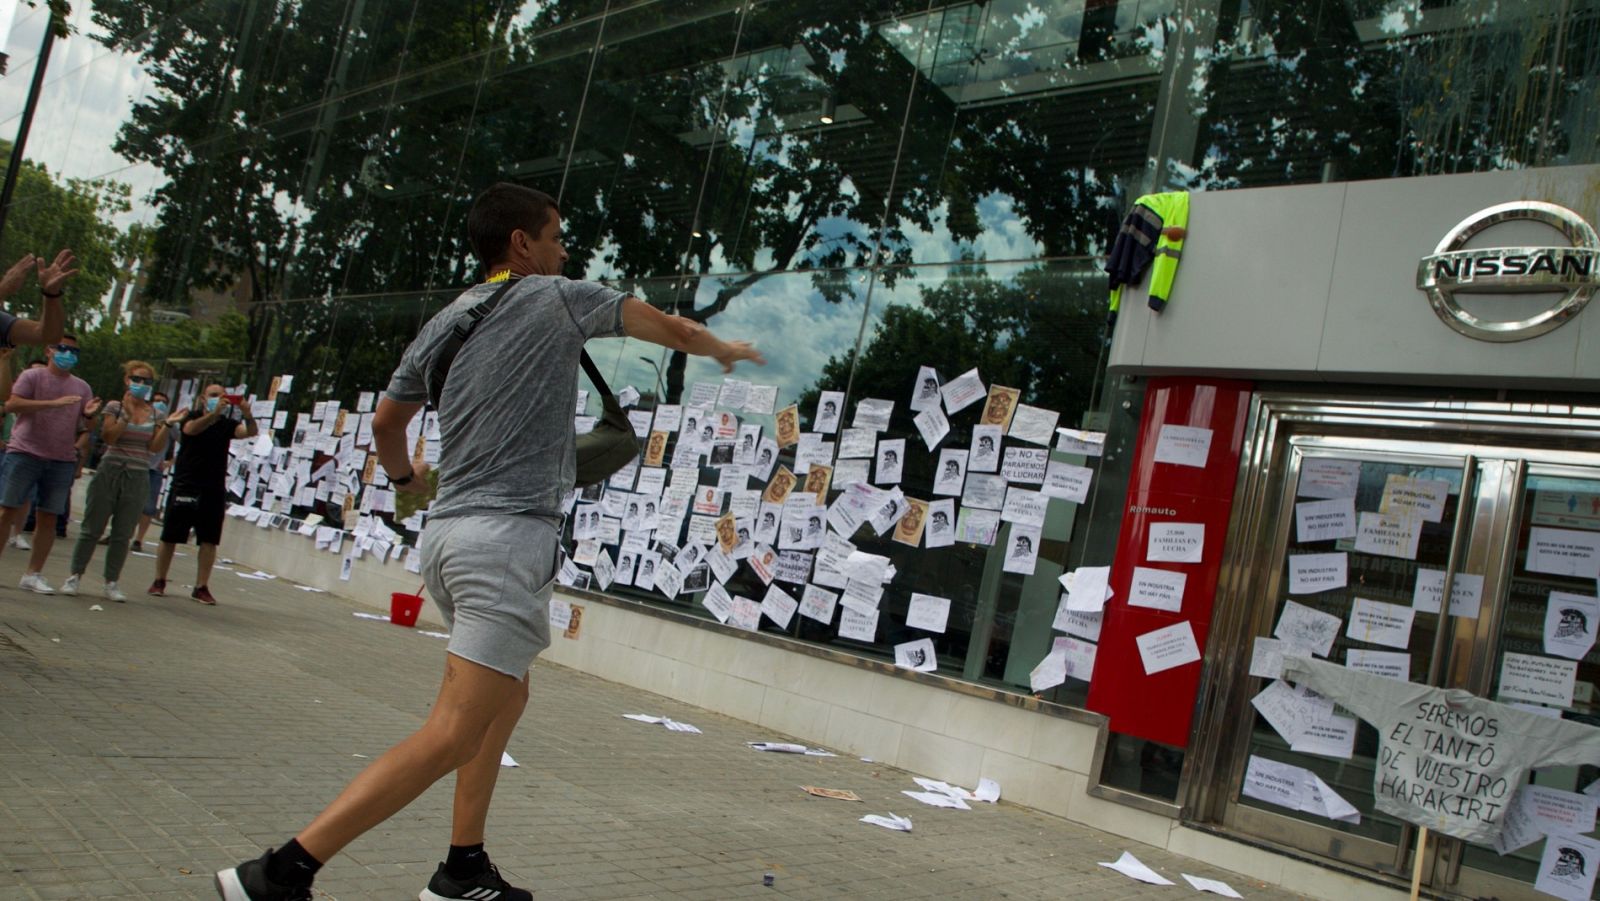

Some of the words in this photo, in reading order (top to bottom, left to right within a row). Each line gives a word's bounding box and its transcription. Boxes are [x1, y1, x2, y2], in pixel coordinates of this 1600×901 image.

[1435, 255, 1592, 279] NISSAN
[1019, 450, 1032, 459] NO
[1003, 461, 1045, 470] PARAREMOS
[1013, 471, 1044, 480] LUCHAR
[1130, 505, 1177, 516] Romauto
[790, 553, 801, 562] NO
[1462, 590, 1474, 598] EN
[1416, 702, 1498, 738] SEREMOS
[1390, 722, 1413, 745] EL
[1381, 746, 1406, 770] DE
[1416, 757, 1507, 799] VUESTRO
[1265, 773, 1295, 787] INDUSTRIA
[1380, 772, 1502, 824] HARAKIRI
